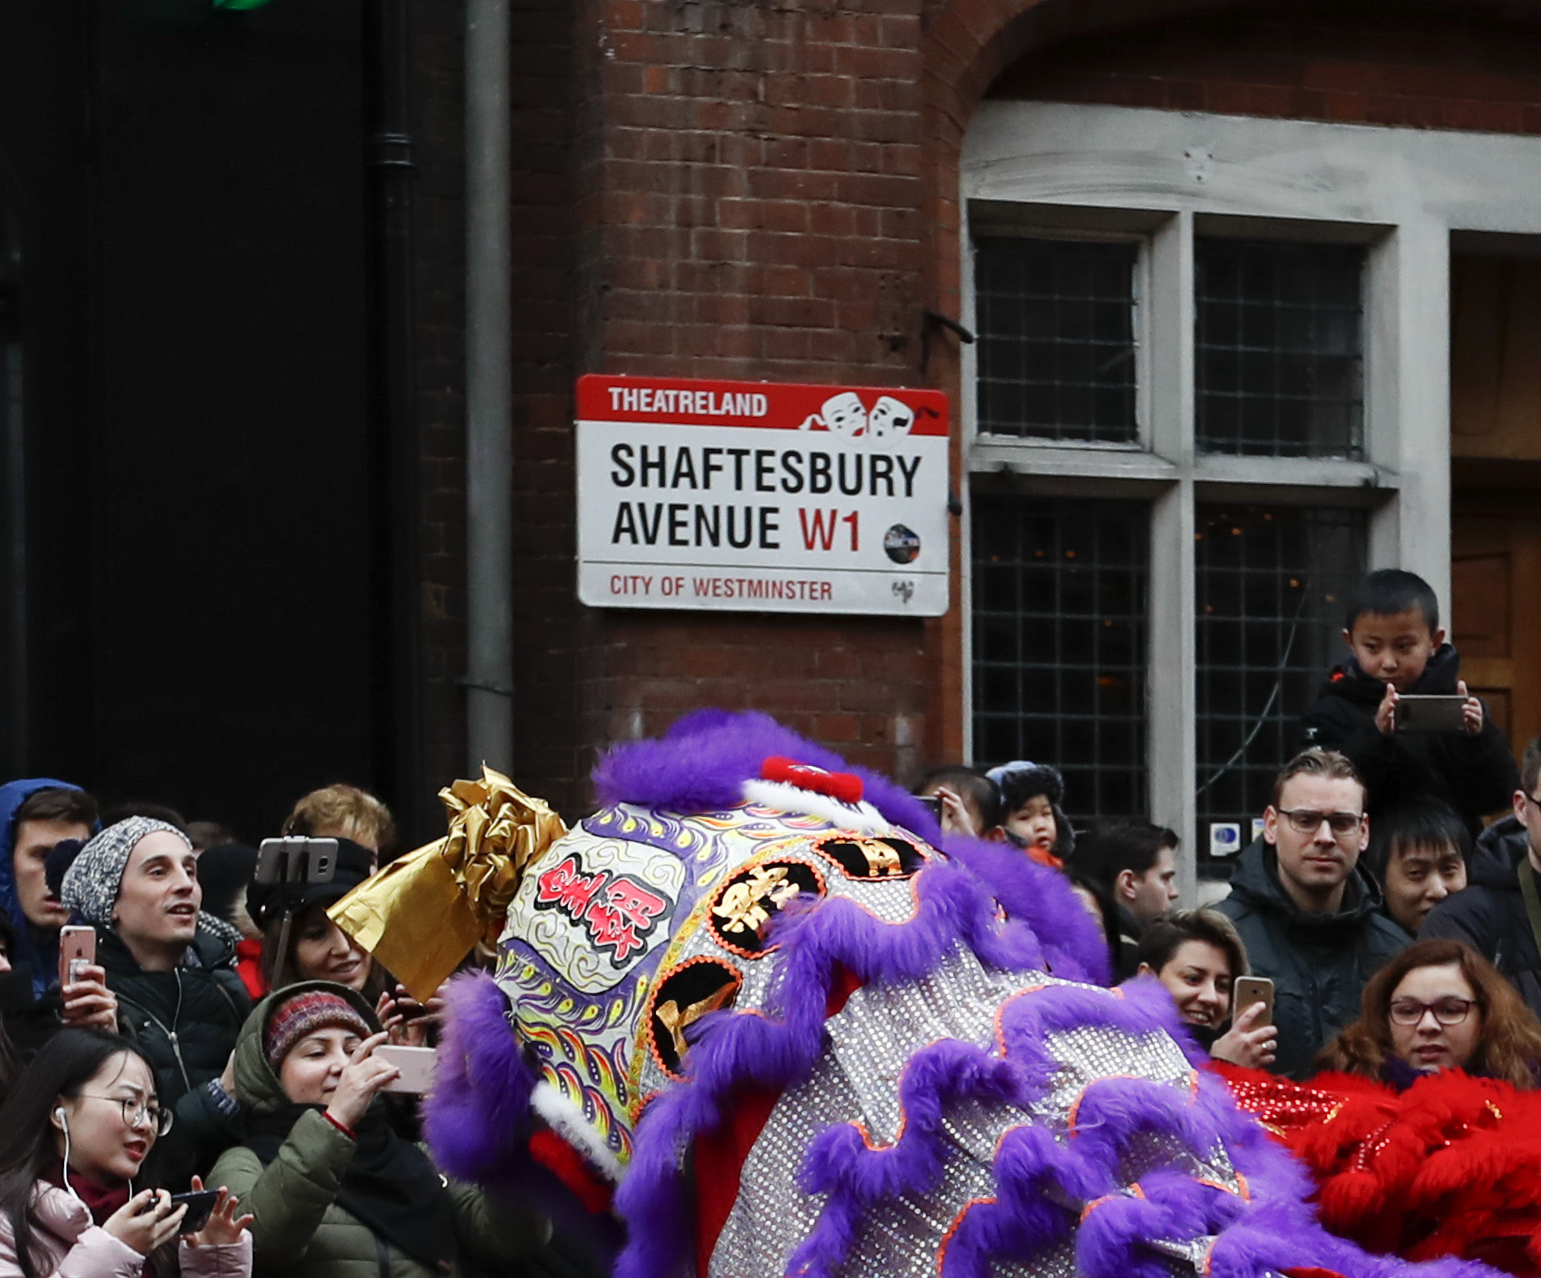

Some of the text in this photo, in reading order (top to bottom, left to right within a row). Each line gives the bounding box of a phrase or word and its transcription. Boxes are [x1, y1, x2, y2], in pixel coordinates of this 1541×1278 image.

[608, 387, 768, 418] THEATRELAND
[610, 443, 922, 498] SHAFTESBURY
[612, 501, 859, 552] AVENUE W1
[610, 574, 833, 601] CITY OF WESTMINSTER
